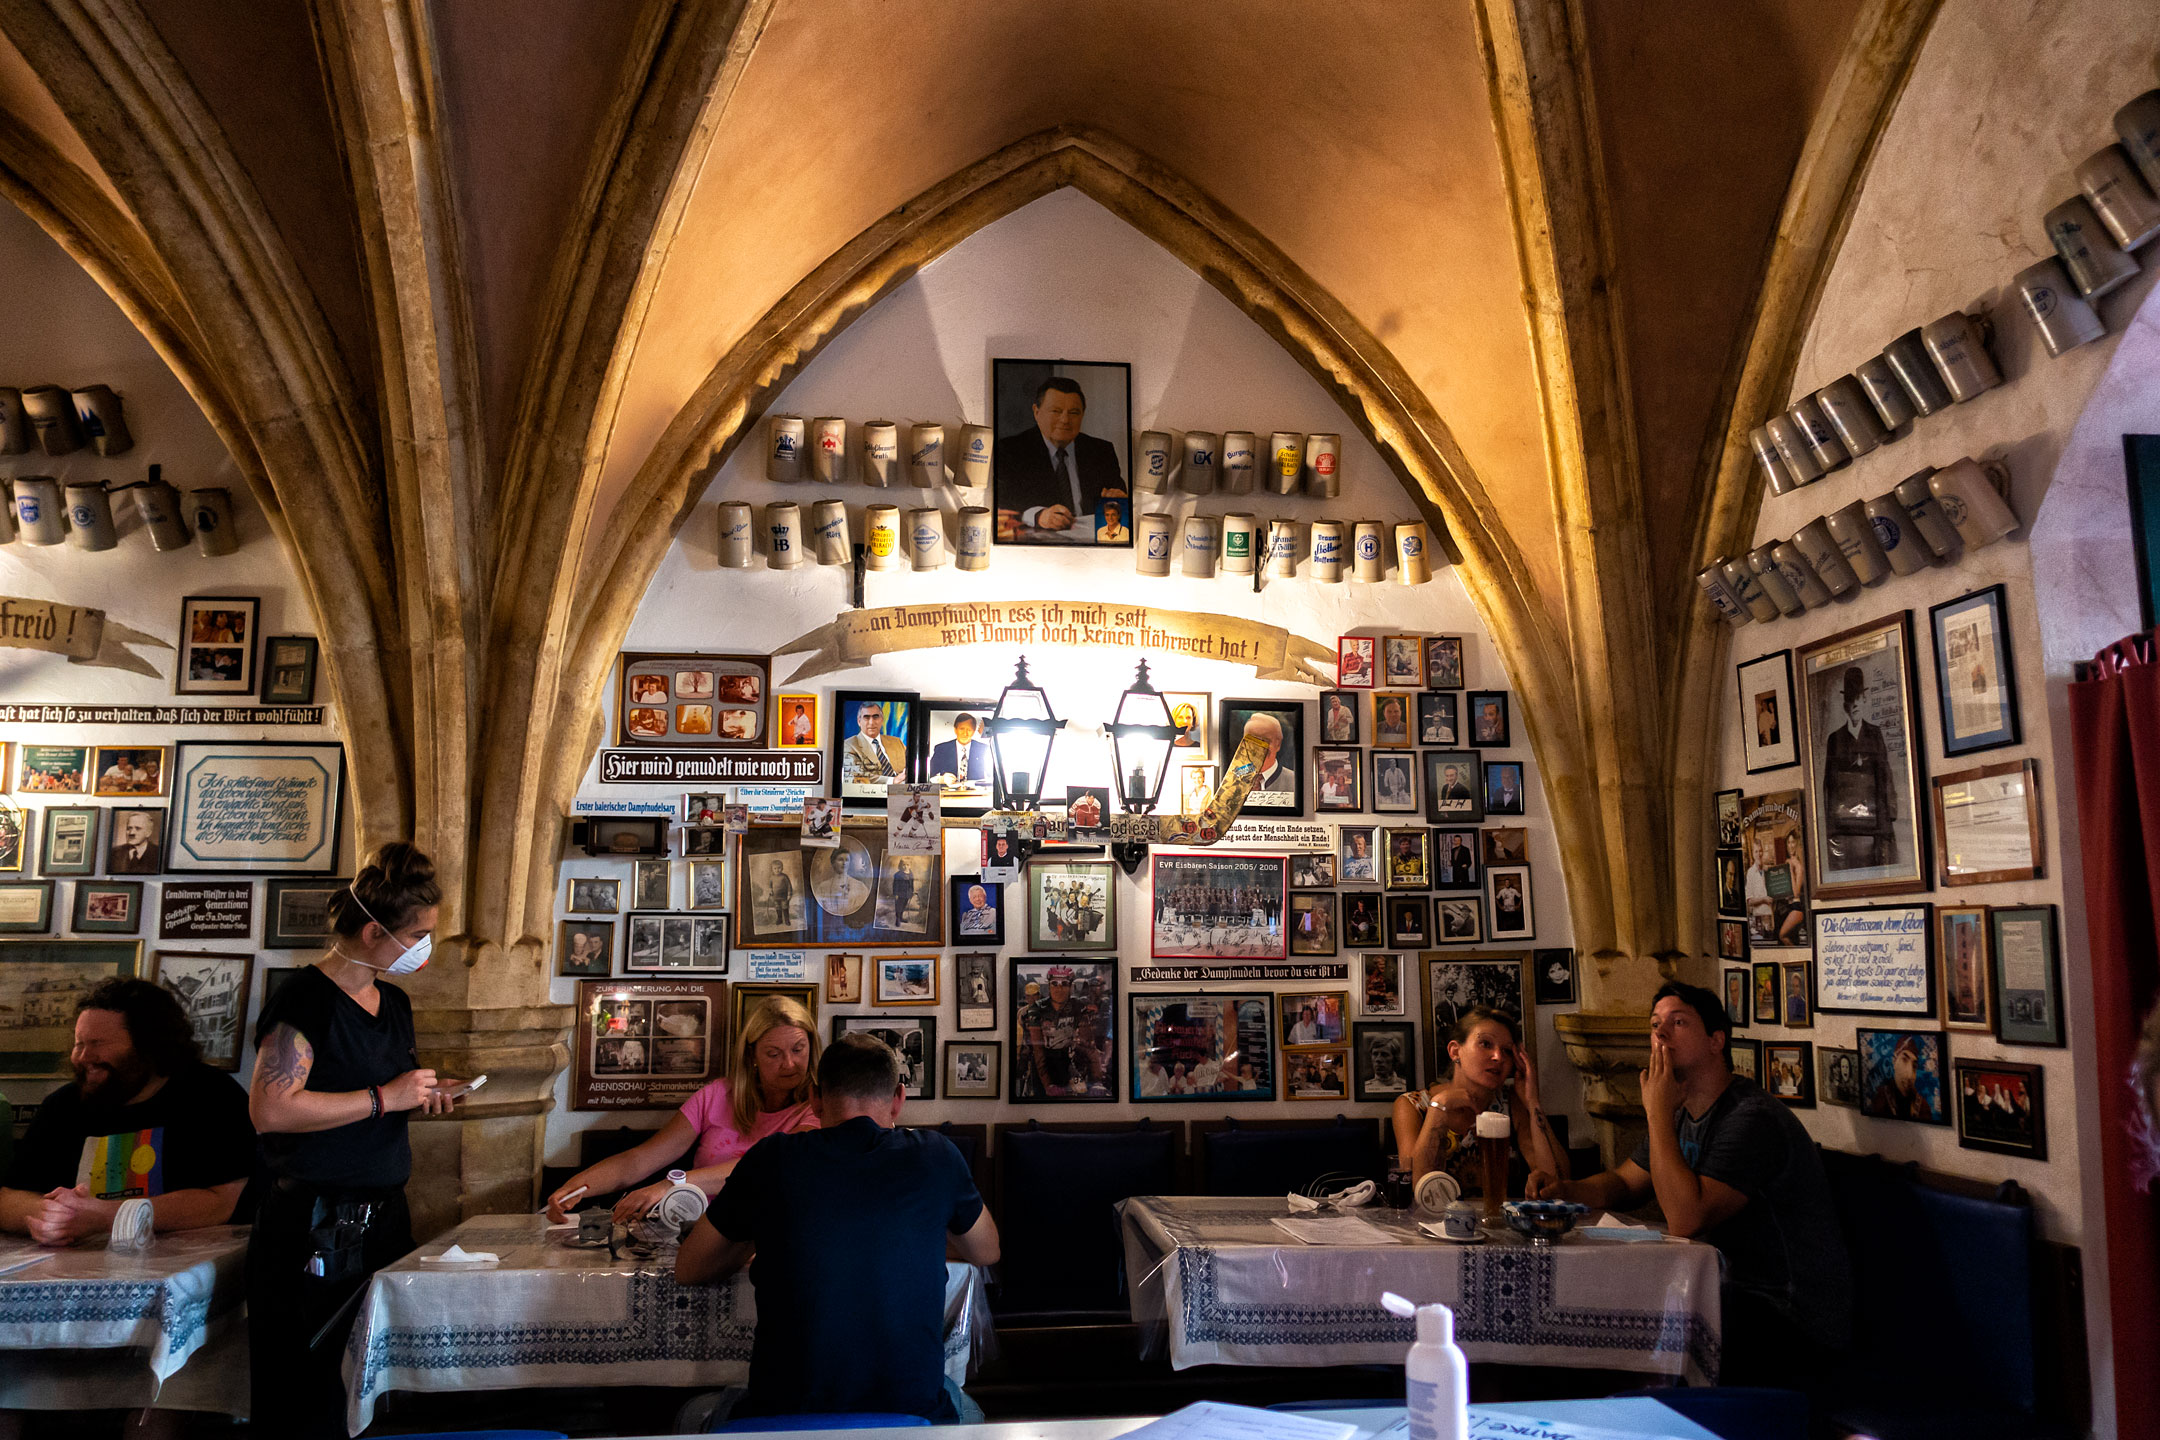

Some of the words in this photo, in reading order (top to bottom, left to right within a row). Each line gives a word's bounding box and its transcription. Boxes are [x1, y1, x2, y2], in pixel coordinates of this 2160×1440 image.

[893, 603, 1002, 629] Dampfnudeln
[1008, 607, 1036, 623] ess
[1041, 603, 1063, 626] ich
[1071, 604, 1107, 627] mich
[940, 623, 977, 645] weil
[981, 622, 1037, 645] Dampf
[1041, 622, 1078, 645] doch
[1082, 625, 1135, 646] keinen
[1140, 629, 1213, 654] Nährwert
[18, 706, 41, 723] hat
[76, 709, 92, 722] zu
[203, 708, 222, 723] der
[223, 708, 252, 723] Wirt
[606, 754, 640, 779] Hier
[640, 756, 673, 776] wird
[675, 756, 733, 779] genudelt
[734, 757, 760, 776] wie
[760, 757, 791, 780] noch
[793, 757, 816, 776] nie
[1258, 825, 1275, 833] Krieg
[1287, 825, 1303, 833] Ende
[1264, 834, 1299, 842] Menschheit
[1159, 861, 1174, 869] EVR
[1175, 861, 1207, 871] Eisbären
[1208, 862, 1233, 871] Saison
[205, 900, 249, 910] Generationen
[1183, 967, 1199, 979] der
[1200, 967, 1261, 980] Dampfnudeln
[1263, 966, 1289, 979] bevor
[1290, 965, 1302, 978] du
[1303, 965, 1317, 978] sie
